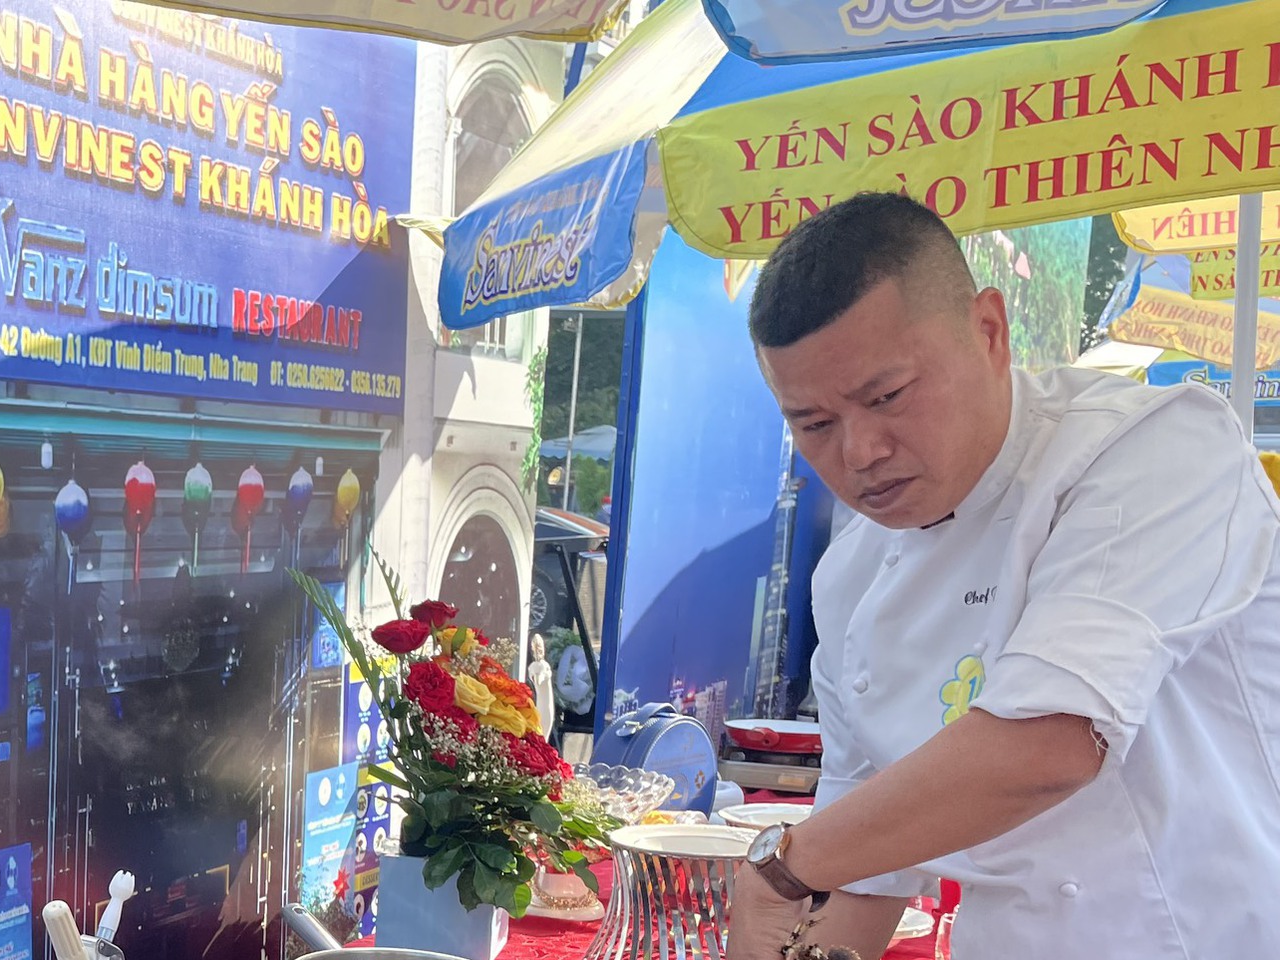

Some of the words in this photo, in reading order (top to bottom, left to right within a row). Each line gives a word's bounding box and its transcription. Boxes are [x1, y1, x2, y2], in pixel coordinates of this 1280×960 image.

[99, 38, 215, 131] HÀNG
[220, 83, 291, 156] YẾN
[300, 107, 365, 176] SÀO
[735, 119, 851, 172] YẾN
[867, 94, 983, 158] SÀO
[999, 53, 1245, 131] KHÁNH
[198, 157, 323, 232] KHÁNH
[329, 182, 391, 248] HÒA
[984, 133, 1184, 209] THIÊN
[97, 243, 219, 328] dimsum
[231, 288, 362, 351] RESTAURANT
[463, 213, 595, 309] Sanvinest
[21, 326, 63, 366] Đường
[89, 336, 114, 368] KĐT
[143, 341, 172, 374] Điểm
[175, 349, 207, 382] Trung,
[209, 353, 229, 381] Nha
[232, 355, 258, 386] Trang
[964, 587, 990, 605] Chef
